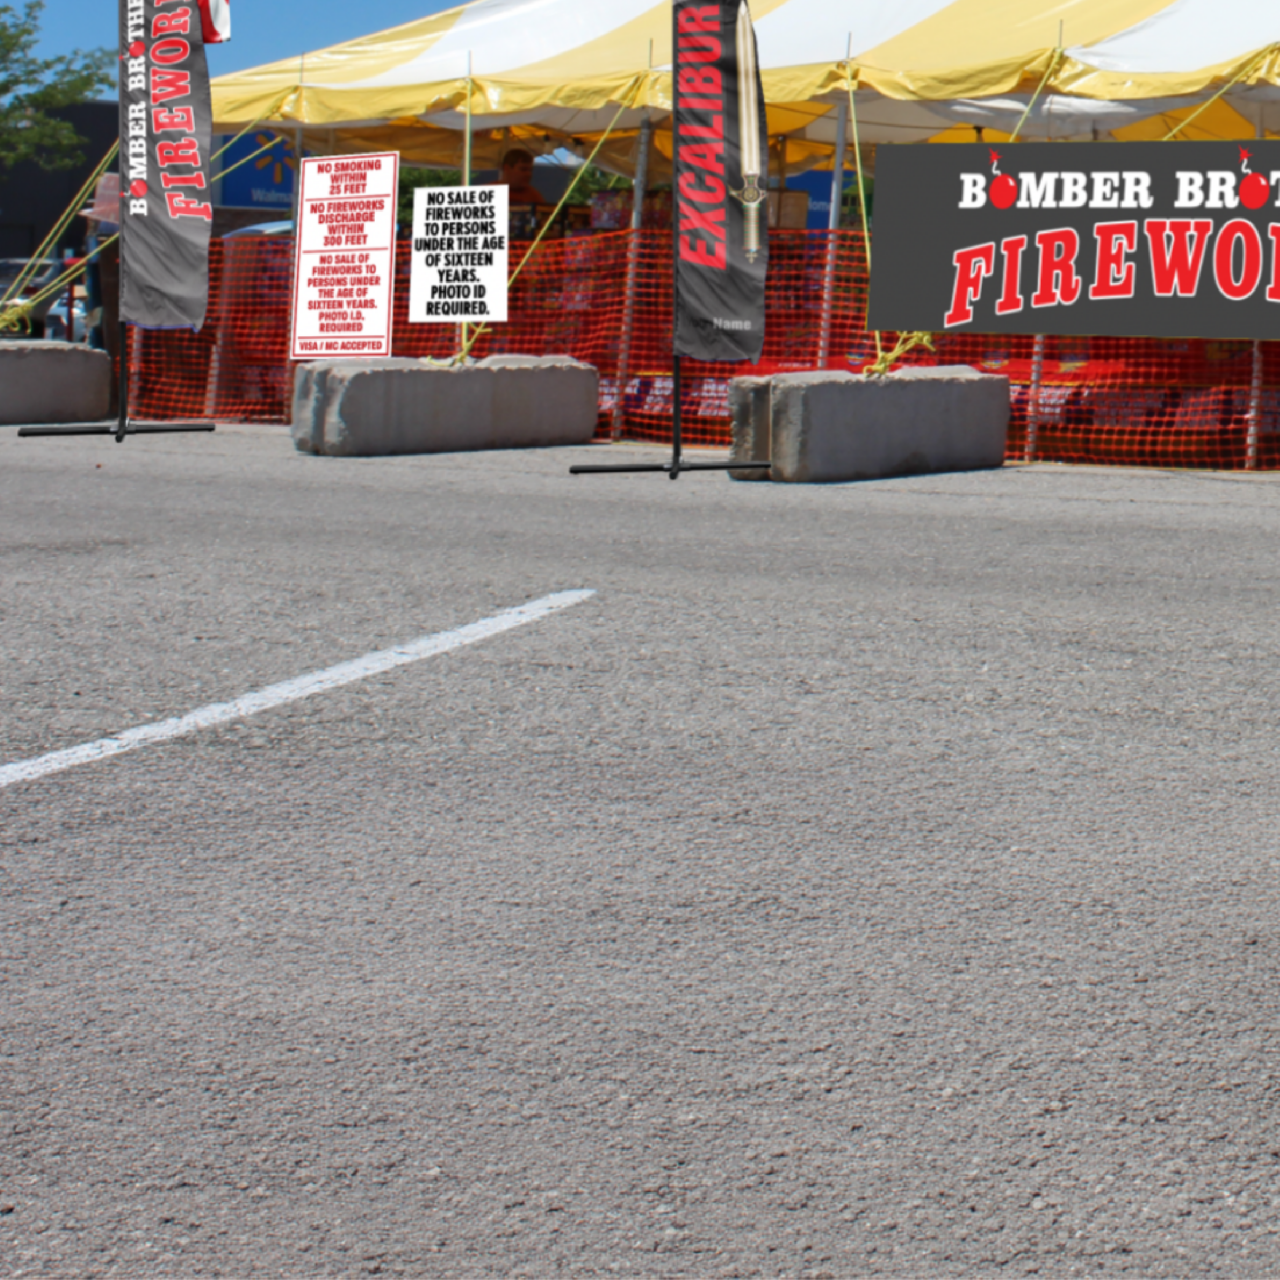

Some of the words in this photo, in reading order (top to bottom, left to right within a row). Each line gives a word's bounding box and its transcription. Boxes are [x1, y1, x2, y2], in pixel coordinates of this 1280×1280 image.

[678, 4, 726, 270] EXCALIBUR
[317, 163, 332, 173] NO
[334, 159, 382, 172] SMOKING
[330, 172, 367, 183] WITHIN
[329, 185, 341, 195] 25
[344, 183, 367, 194] FEET
[427, 192, 445, 206] NO
[447, 191, 476, 205] SALE
[478, 190, 494, 203] OF
[310, 202, 325, 214] NO
[327, 199, 384, 213] FIREWORKS
[318, 211, 375, 224] DISCHARGE
[426, 206, 495, 221] FIREWORKS
[327, 223, 364, 235] WITHIN
[424, 222, 439, 236] TO
[442, 221, 496, 236] PERSONS
[323, 235, 342, 246] 300
[345, 234, 368, 245] FEET
[414, 238, 454, 251] UNDER
[457, 237, 479, 251] THE
[481, 236, 505, 250] AGE
[319, 255, 332, 265] NO
[334, 254, 356, 264] SALE
[358, 253, 370, 263] OF
[425, 254, 441, 267] OF
[444, 252, 493, 266] SIXTEEN
[312, 265, 362, 276] FIREWORKS
[365, 264, 376, 274] TO
[438, 269, 480, 283] YEARS.
[308, 277, 347, 287] PERSONS
[350, 276, 381, 286] UNDER
[318, 288, 334, 298] THE
[336, 287, 354, 298] AGE
[356, 287, 368, 297] OF
[431, 285, 471, 299] PHOTO
[473, 285, 486, 299] ID
[308, 300, 344, 310] SIXTEEN
[346, 299, 377, 309] YEARS.
[426, 301, 490, 316] REQUIRED.
[318, 311, 348, 321] PHOTO
[319, 322, 363, 332] REQUIRED
[713, 317, 751, 330] Name
[299, 341, 318, 350] VISA
[325, 341, 339, 350] MC
[340, 341, 382, 350] ACCEPTED
